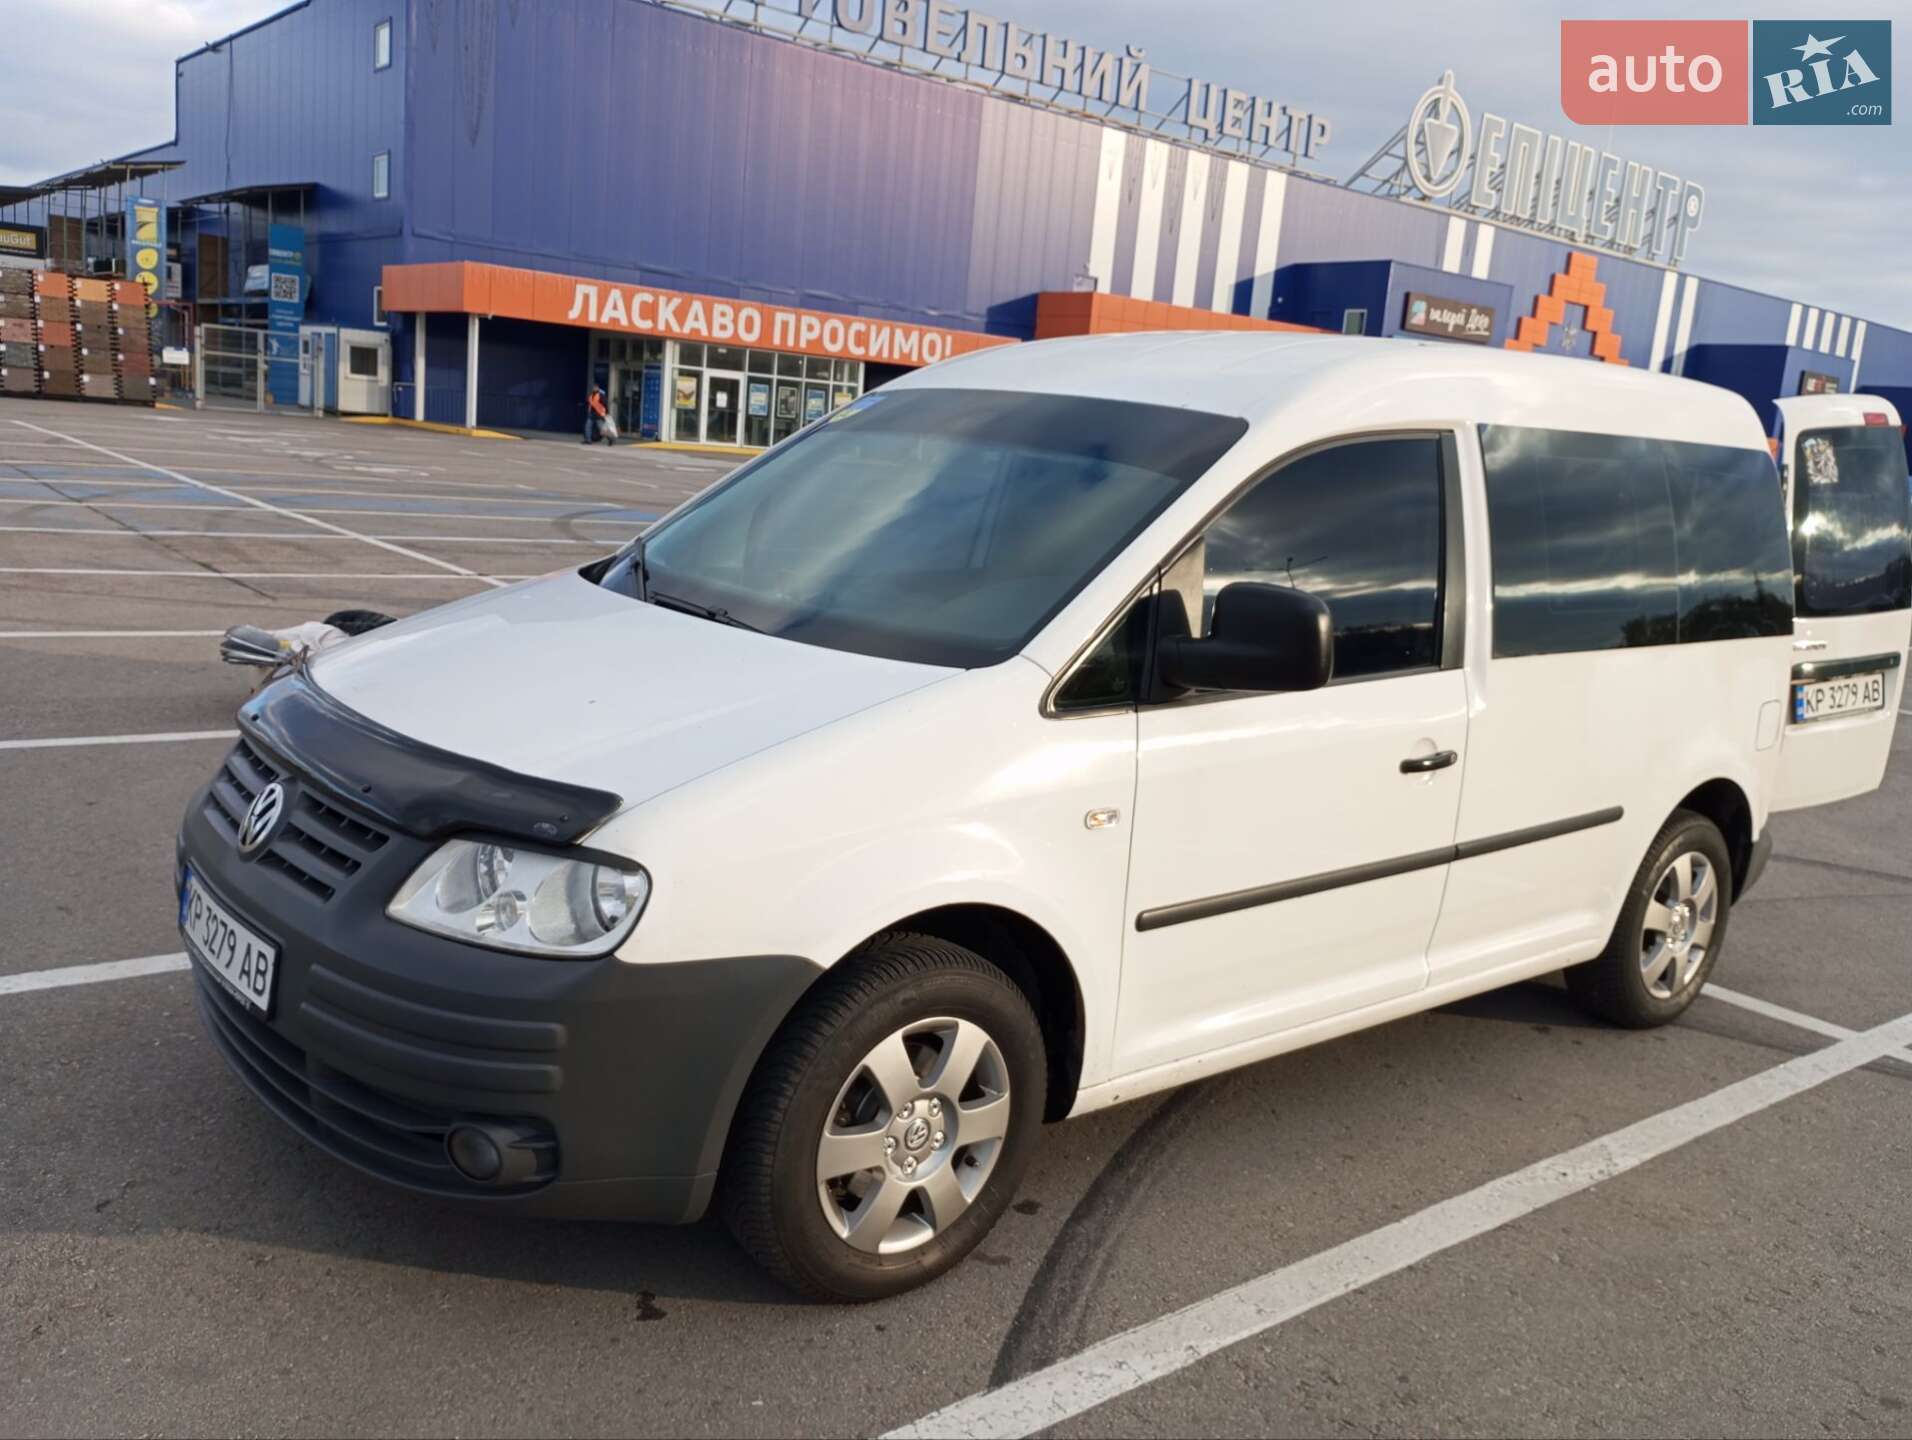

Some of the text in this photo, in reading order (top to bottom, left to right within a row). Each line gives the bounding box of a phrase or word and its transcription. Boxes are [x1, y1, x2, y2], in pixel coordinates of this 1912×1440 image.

[799, 0, 1332, 159] ОВЕЛЬНИЙ ЦЕНТР
[1470, 112, 1705, 263] ЕПІЦЕНТР
[567, 283, 761, 341] ЛАСКАВО
[1828, 684, 1859, 709] 3279
[202, 902, 237, 969] 3279
